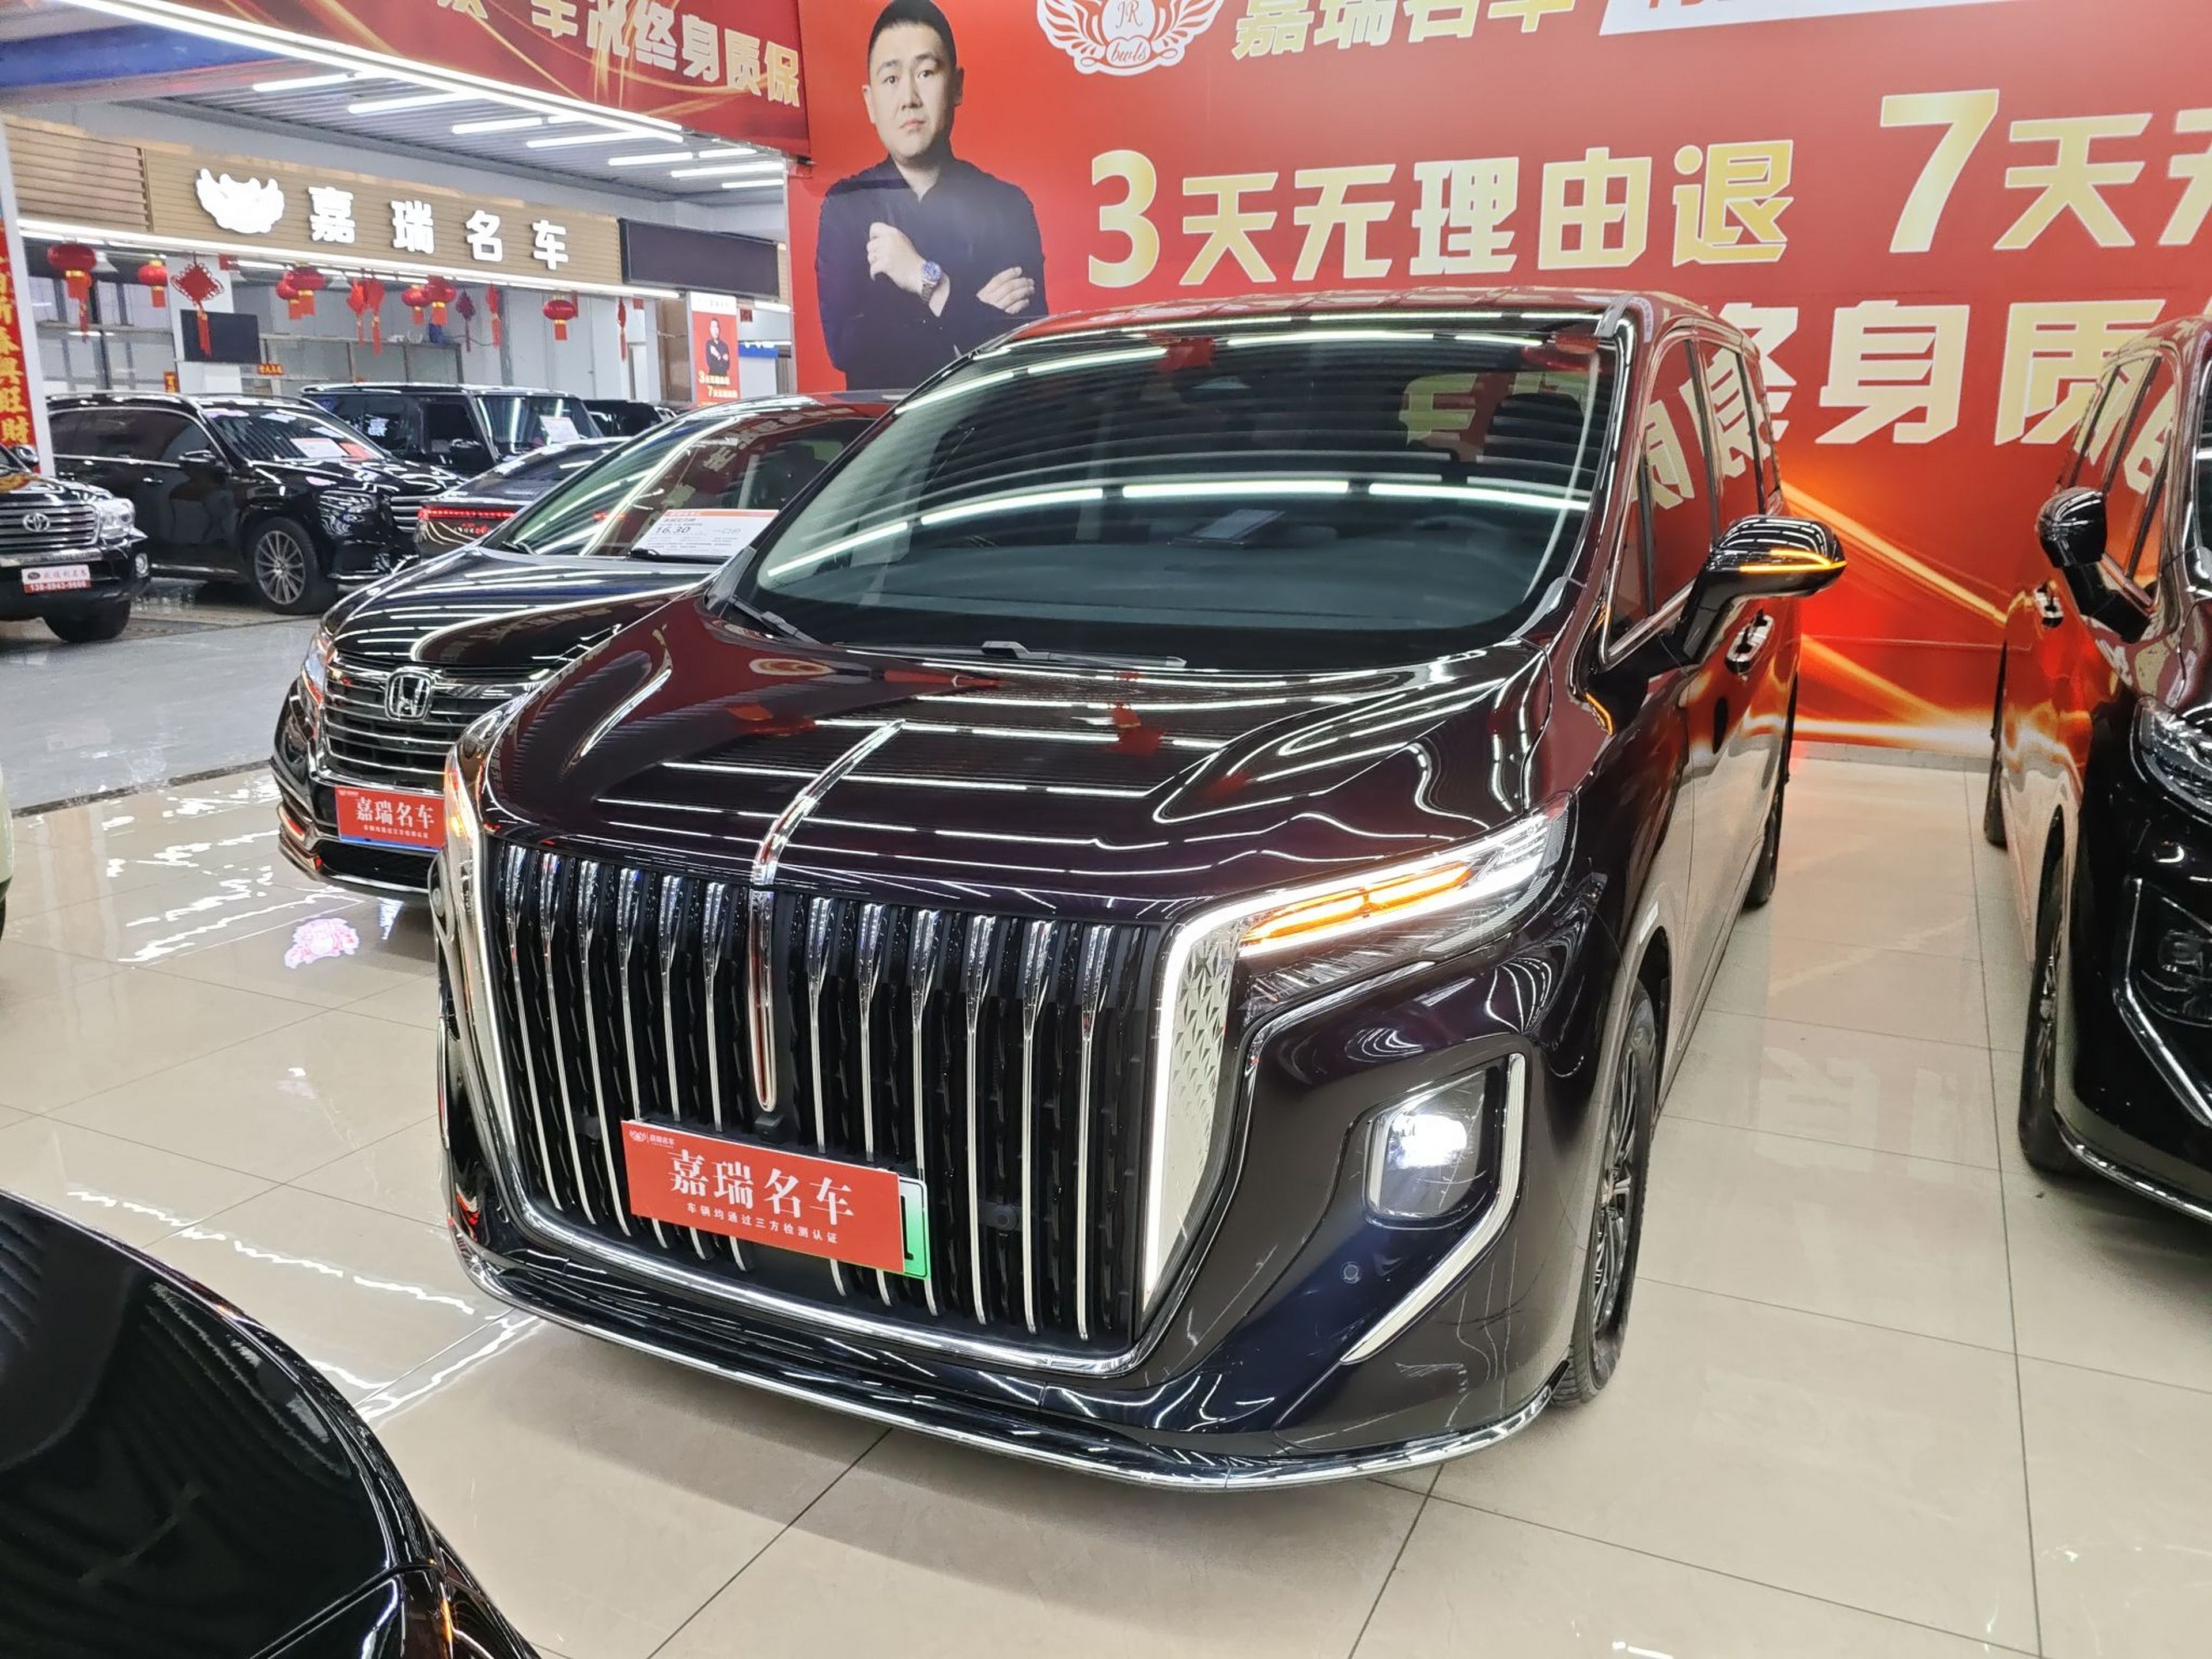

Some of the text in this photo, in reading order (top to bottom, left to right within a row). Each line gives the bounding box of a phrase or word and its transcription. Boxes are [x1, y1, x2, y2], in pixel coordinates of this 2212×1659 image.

[306, 185, 569, 271] 嘉瑞名车
[1088, 139, 1794, 288] 3天无理由退
[356, 796, 435, 830] 嘉瑞名车
[666, 1148, 855, 1226] 嘉瑞名车
[685, 1201, 839, 1245] 车辆均通过三方检测认证
